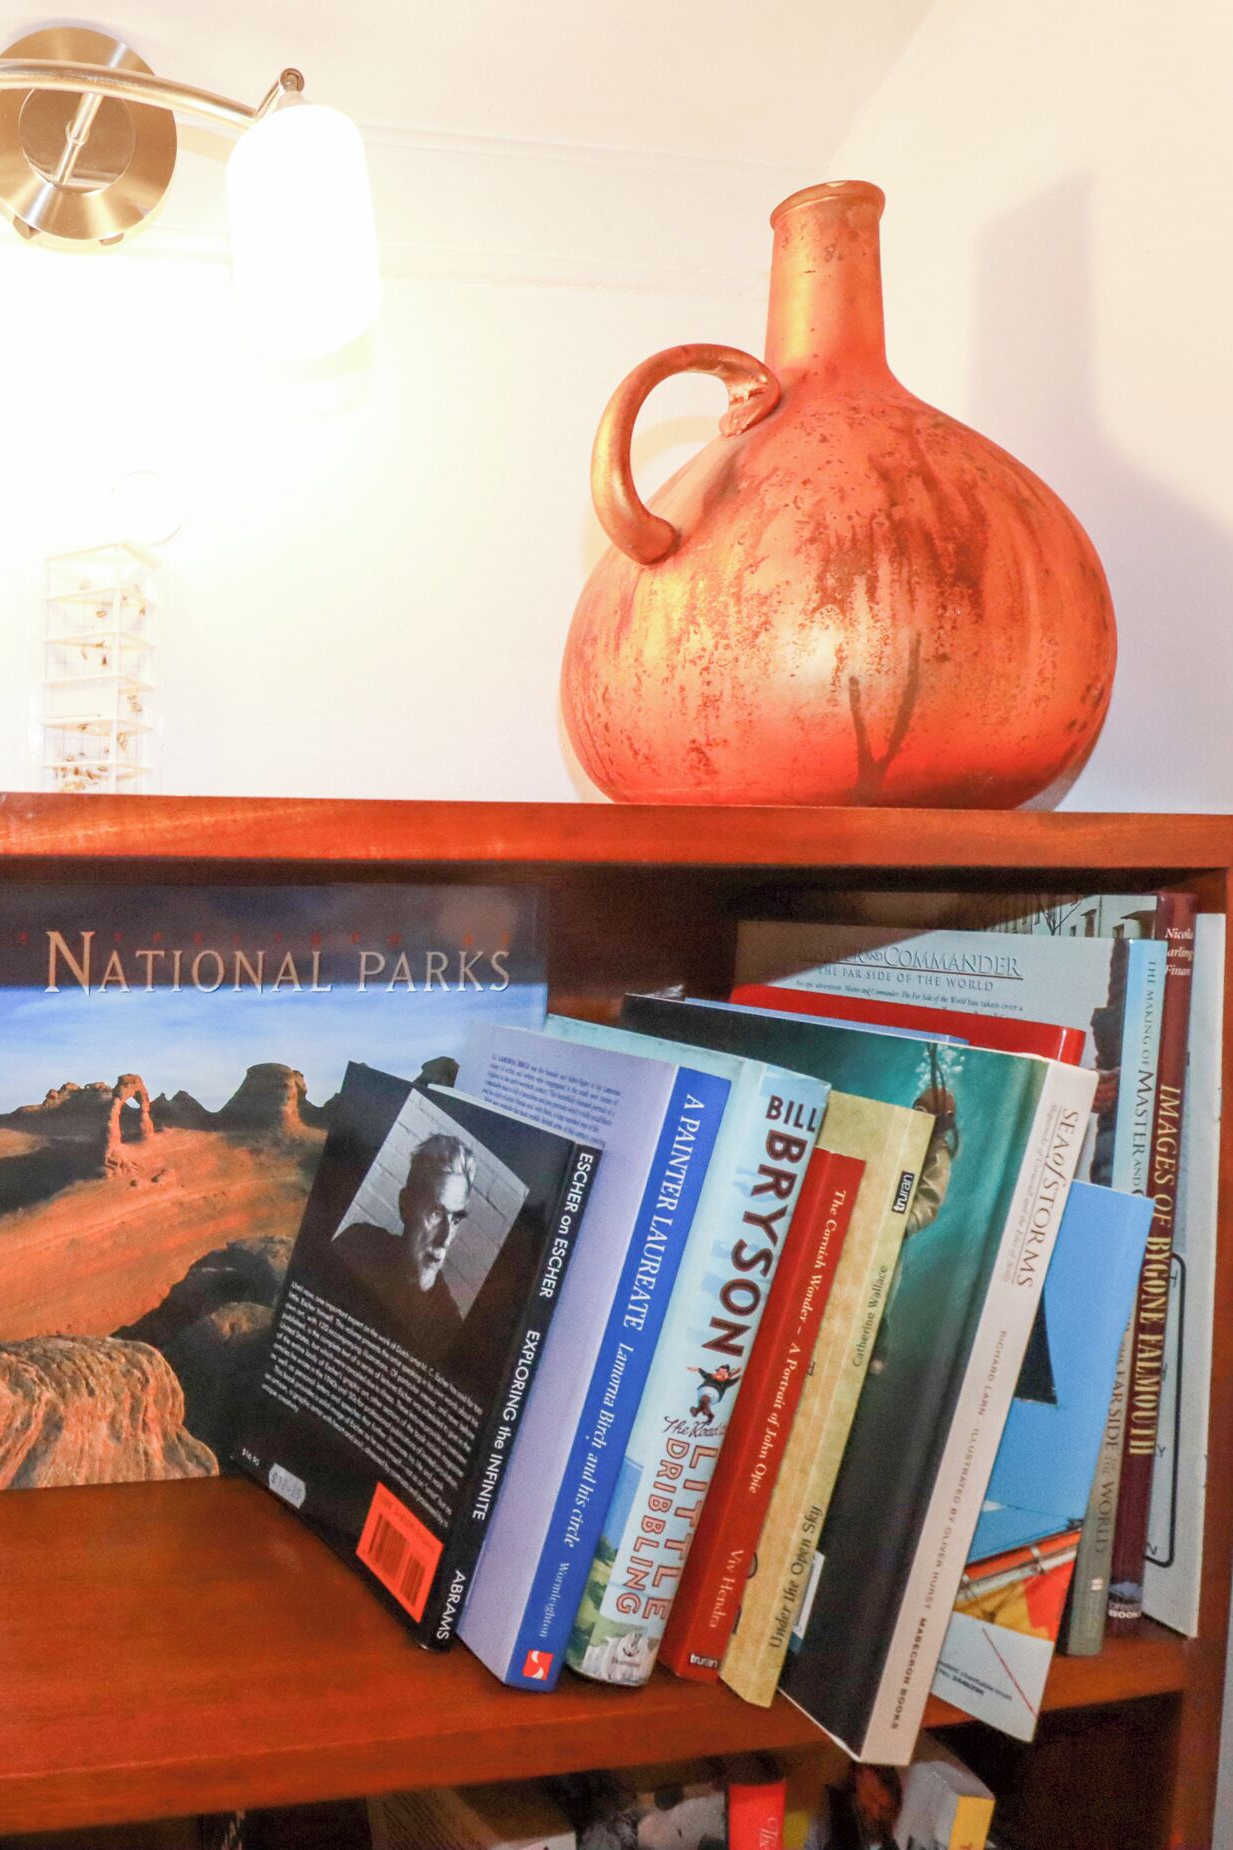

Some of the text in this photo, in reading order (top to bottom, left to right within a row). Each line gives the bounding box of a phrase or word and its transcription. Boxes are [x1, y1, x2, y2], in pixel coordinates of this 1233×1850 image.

[44, 931, 511, 996] NATIONAL PARKS
[843, 967, 862, 978] FAR
[864, 969, 891, 981] SIDE
[896, 971, 910, 983] OF
[917, 973, 940, 986] THE
[946, 976, 993, 991] WORLD
[883, 946, 1022, 977] COMMANDER
[1145, 961, 1157, 983] THE
[1167, 947, 1193, 961] arling
[1142, 990, 1155, 1043] MAKING
[1140, 1050, 1151, 1064] OF
[766, 1095, 818, 1134] BILL
[1051, 1107, 1079, 1152] SEA
[1131, 1069, 1154, 1154] MASTER
[538, 1152, 594, 1299] ESCHER on ESCHER
[621, 1093, 706, 1331] A PAINTER LAUREATE
[892, 1172, 913, 1213] truran
[701, 1129, 808, 1357] BRYSON
[1014, 1178, 1061, 1288] STORMS
[1126, 1083, 1182, 1456] IMAGES OF BYGONE FALMOUTH
[745, 1188, 847, 1496] The Cornish Wonder A Portrait of John Opie
[850, 1263, 888, 1368] Catherine Wallace
[471, 1329, 541, 1521] EXPLORING the INFINITE
[562, 1342, 635, 1548] Lamorna Birch and his circle
[662, 1416, 689, 1435] The
[1103, 1408, 1122, 1449] SIDE
[951, 1427, 980, 1505] ILLUSTRATED
[616, 1438, 689, 1615] DRIBBLING
[642, 1443, 718, 1620] LITTLE
[934, 1526, 952, 1569] OLIVER
[946, 1506, 957, 1523] BY
[435, 1570, 467, 1641] ABRAMS
[708, 1548, 745, 1629] Viv Hendra
[767, 1504, 823, 1649] Under the Open Sky
[922, 1571, 940, 1611] HURST
[689, 1653, 718, 1668] truran
[901, 1616, 927, 1686] MABECRON
[889, 1687, 908, 1732] BOOKS
